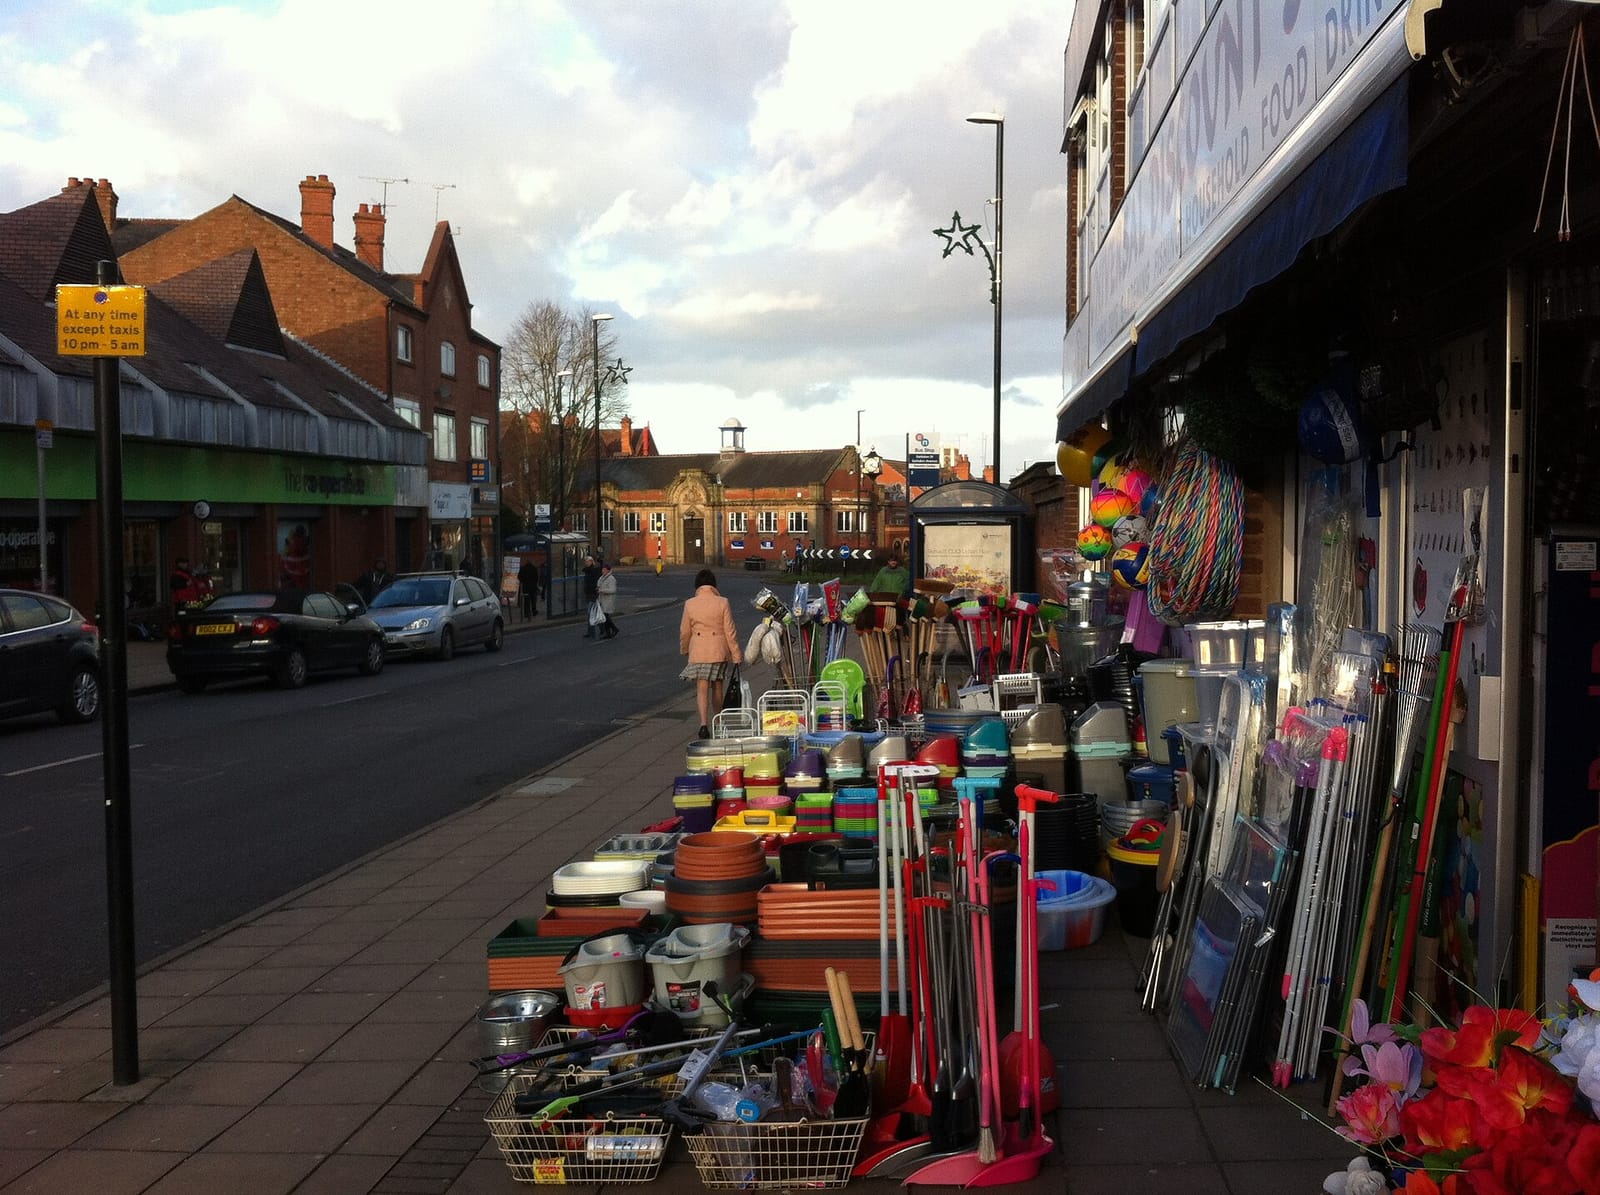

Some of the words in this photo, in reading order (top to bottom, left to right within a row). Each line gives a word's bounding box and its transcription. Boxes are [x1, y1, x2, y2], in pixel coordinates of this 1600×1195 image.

[1186, 126, 1249, 242] HOUSEHOLD
[1261, 45, 1308, 151] FOOD
[65, 309, 80, 319] At
[83, 311, 105, 321] any
[109, 310, 138, 320] time
[63, 324, 105, 336] except
[109, 324, 139, 335] taxis
